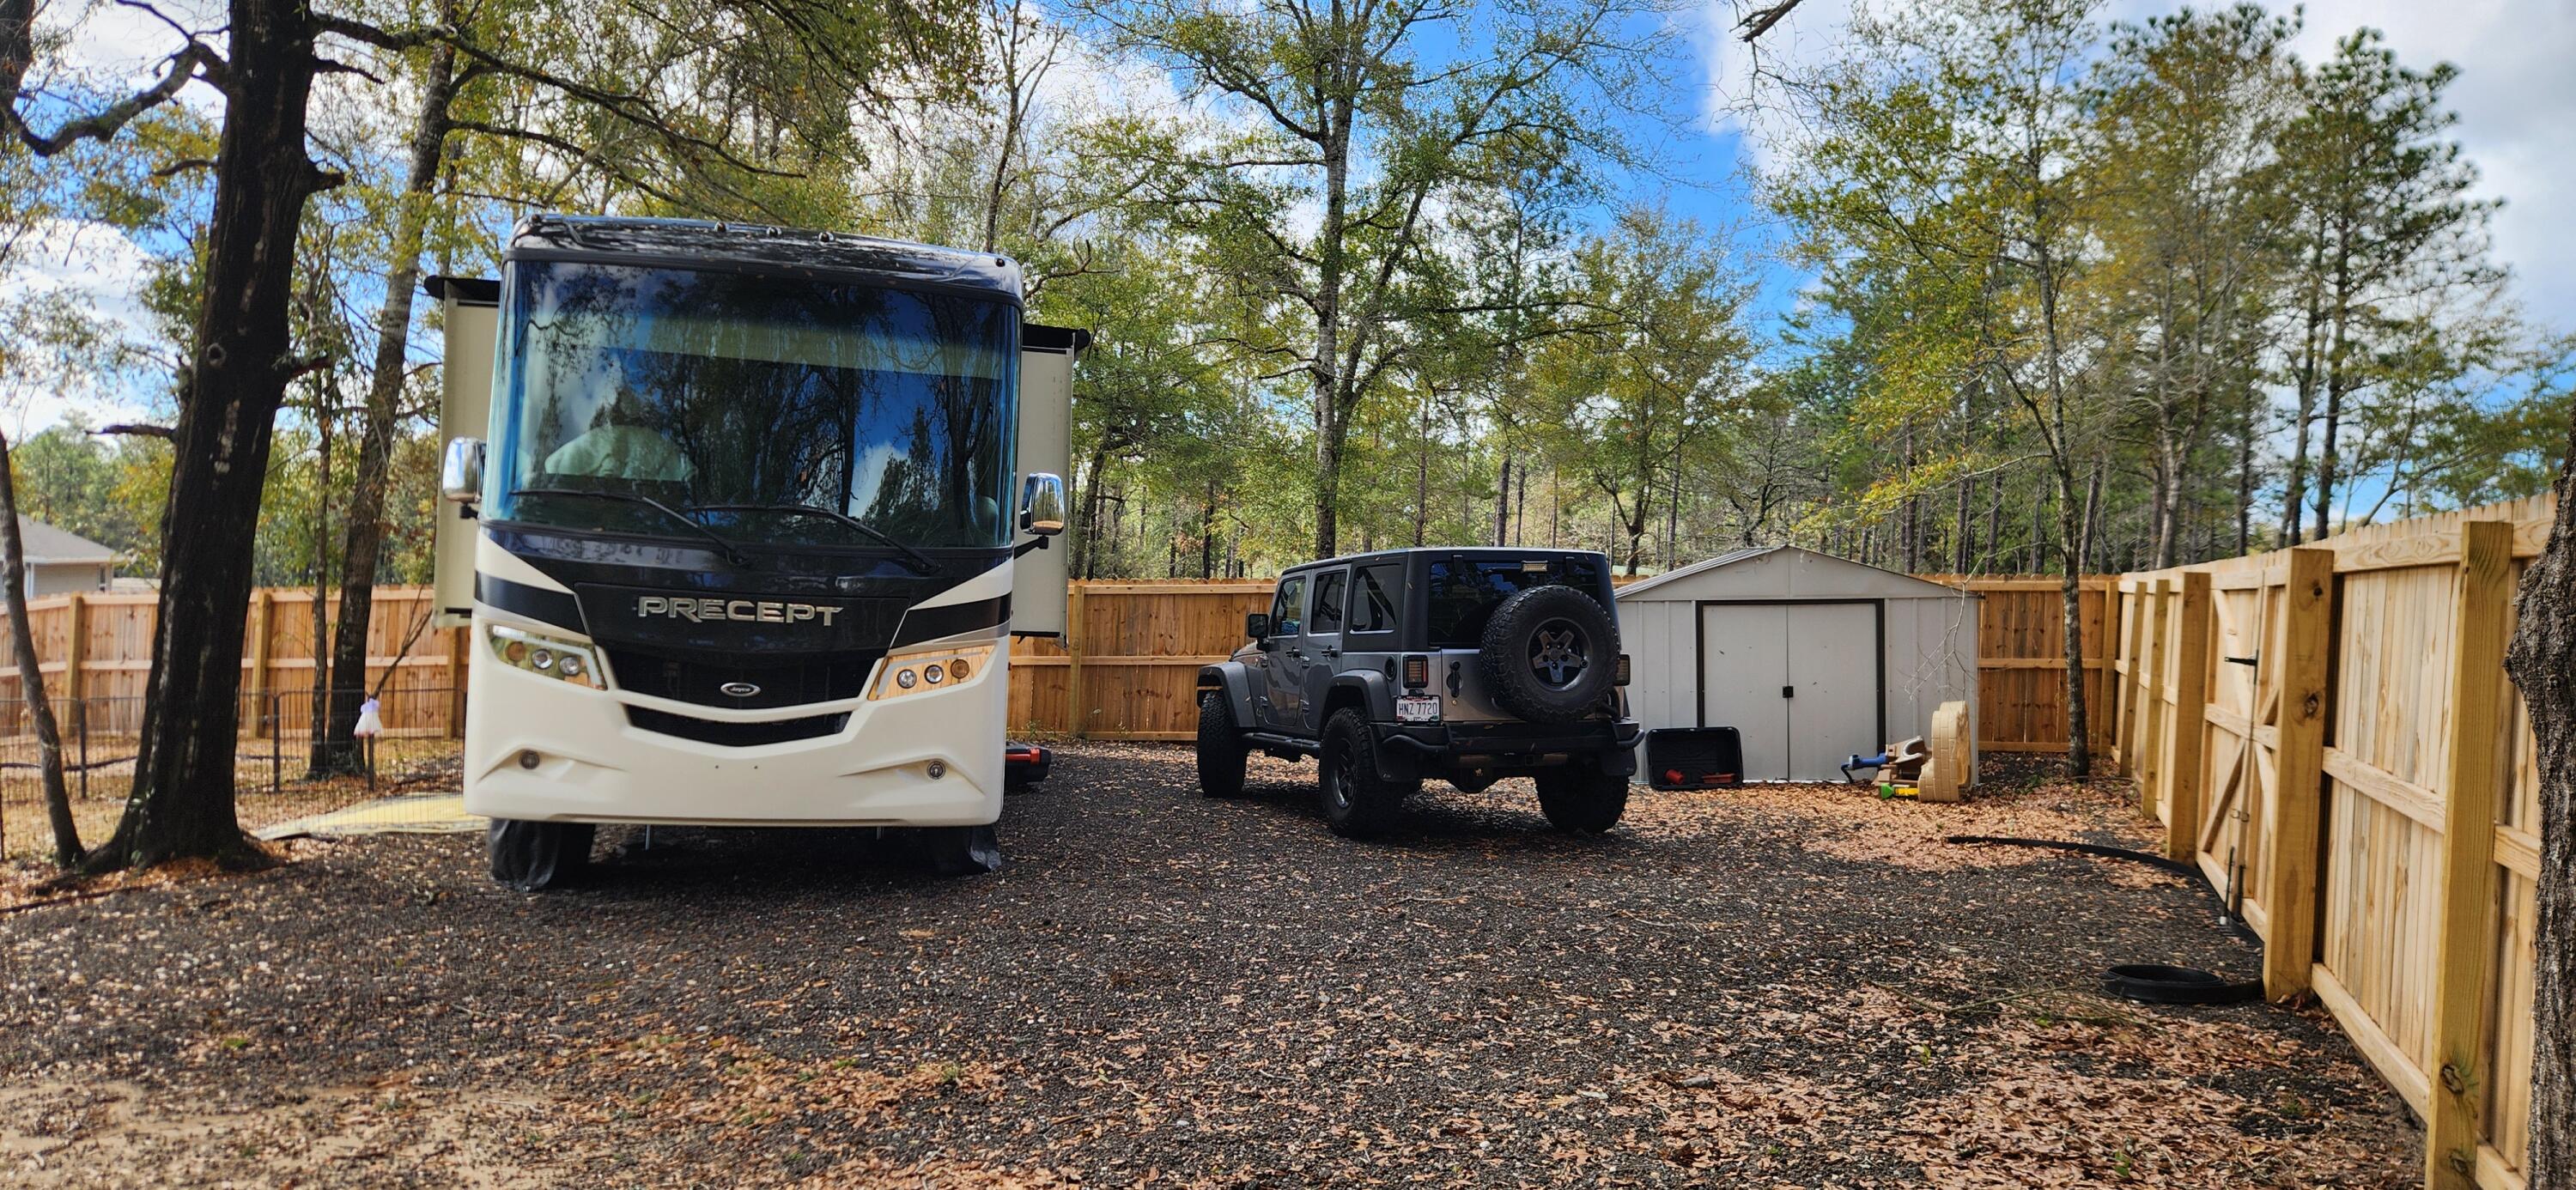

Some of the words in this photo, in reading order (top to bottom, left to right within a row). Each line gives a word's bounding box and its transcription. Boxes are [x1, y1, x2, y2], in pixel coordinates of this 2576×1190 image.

[638, 597, 843, 626] PRECEPT
[1398, 702, 1414, 715] HNZ
[1416, 702, 1438, 715] 7720
